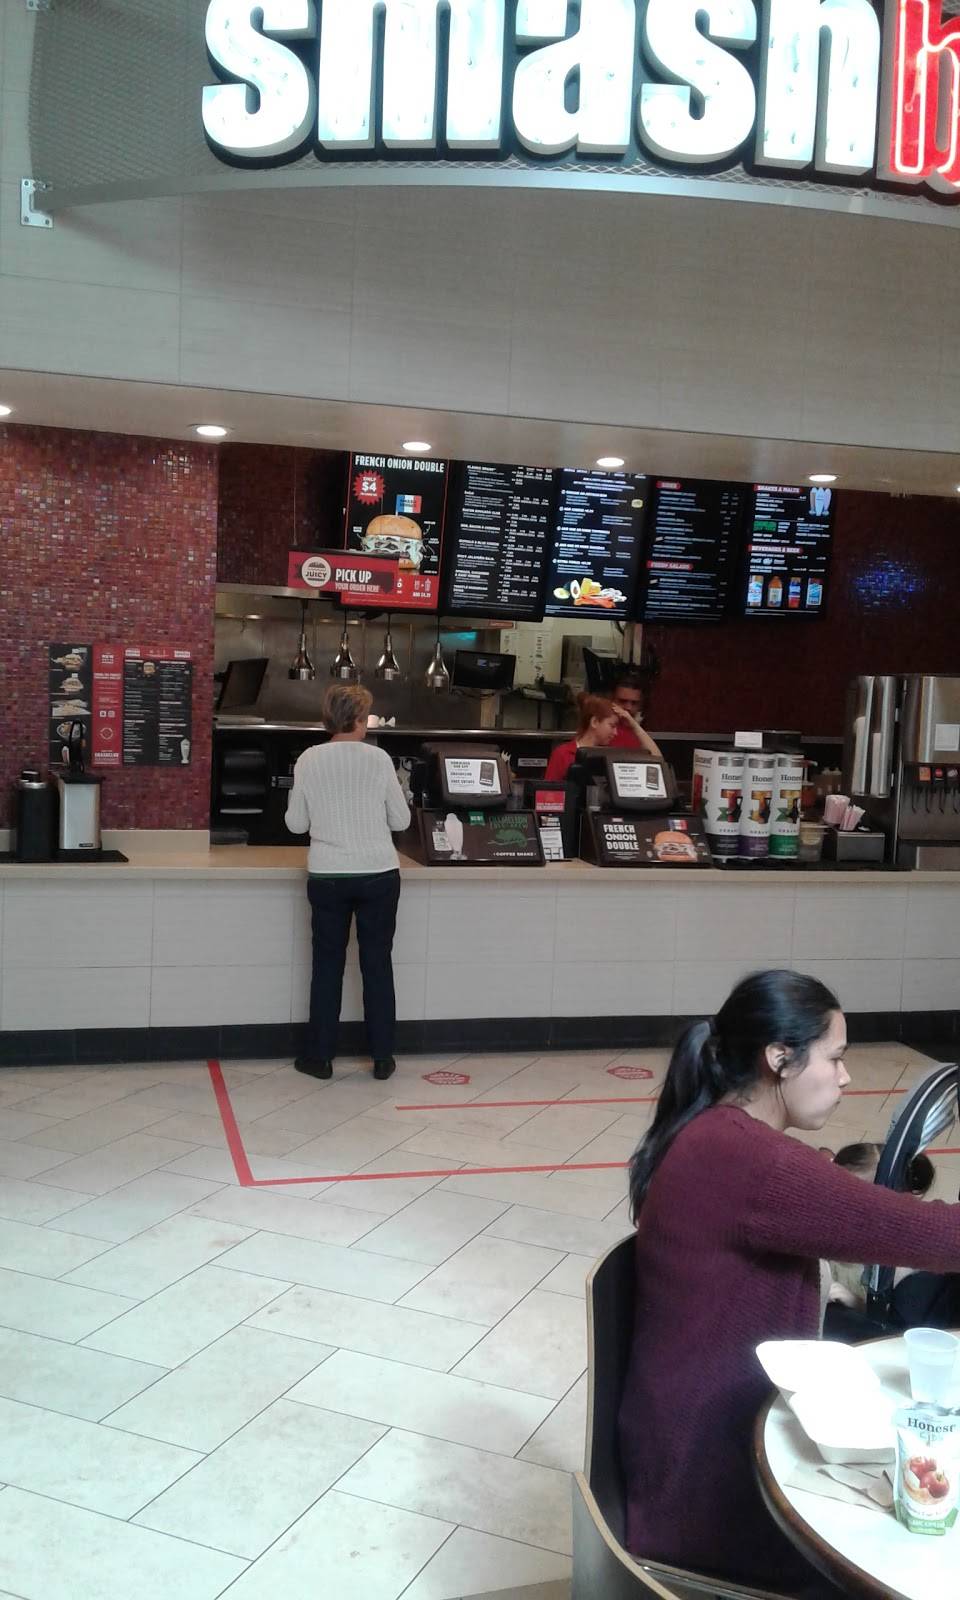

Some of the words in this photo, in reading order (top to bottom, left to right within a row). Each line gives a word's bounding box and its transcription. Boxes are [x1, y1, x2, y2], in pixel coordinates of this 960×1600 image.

[355, 455, 386, 468] FRENCH
[387, 458, 413, 470] ONION
[414, 460, 445, 473] DOUBLE
[362, 481, 377, 492] $4
[335, 568, 356, 583] PICK
[358, 570, 372, 584] UP
[335, 582, 349, 591] YOUR
[349, 583, 367, 592] ORDER
[367, 584, 380, 593] HERE
[603, 824, 636, 833] FRENCH
[605, 833, 637, 841] ONION
[606, 841, 640, 850] DOUBLE
[907, 1417, 956, 1433] Honest
